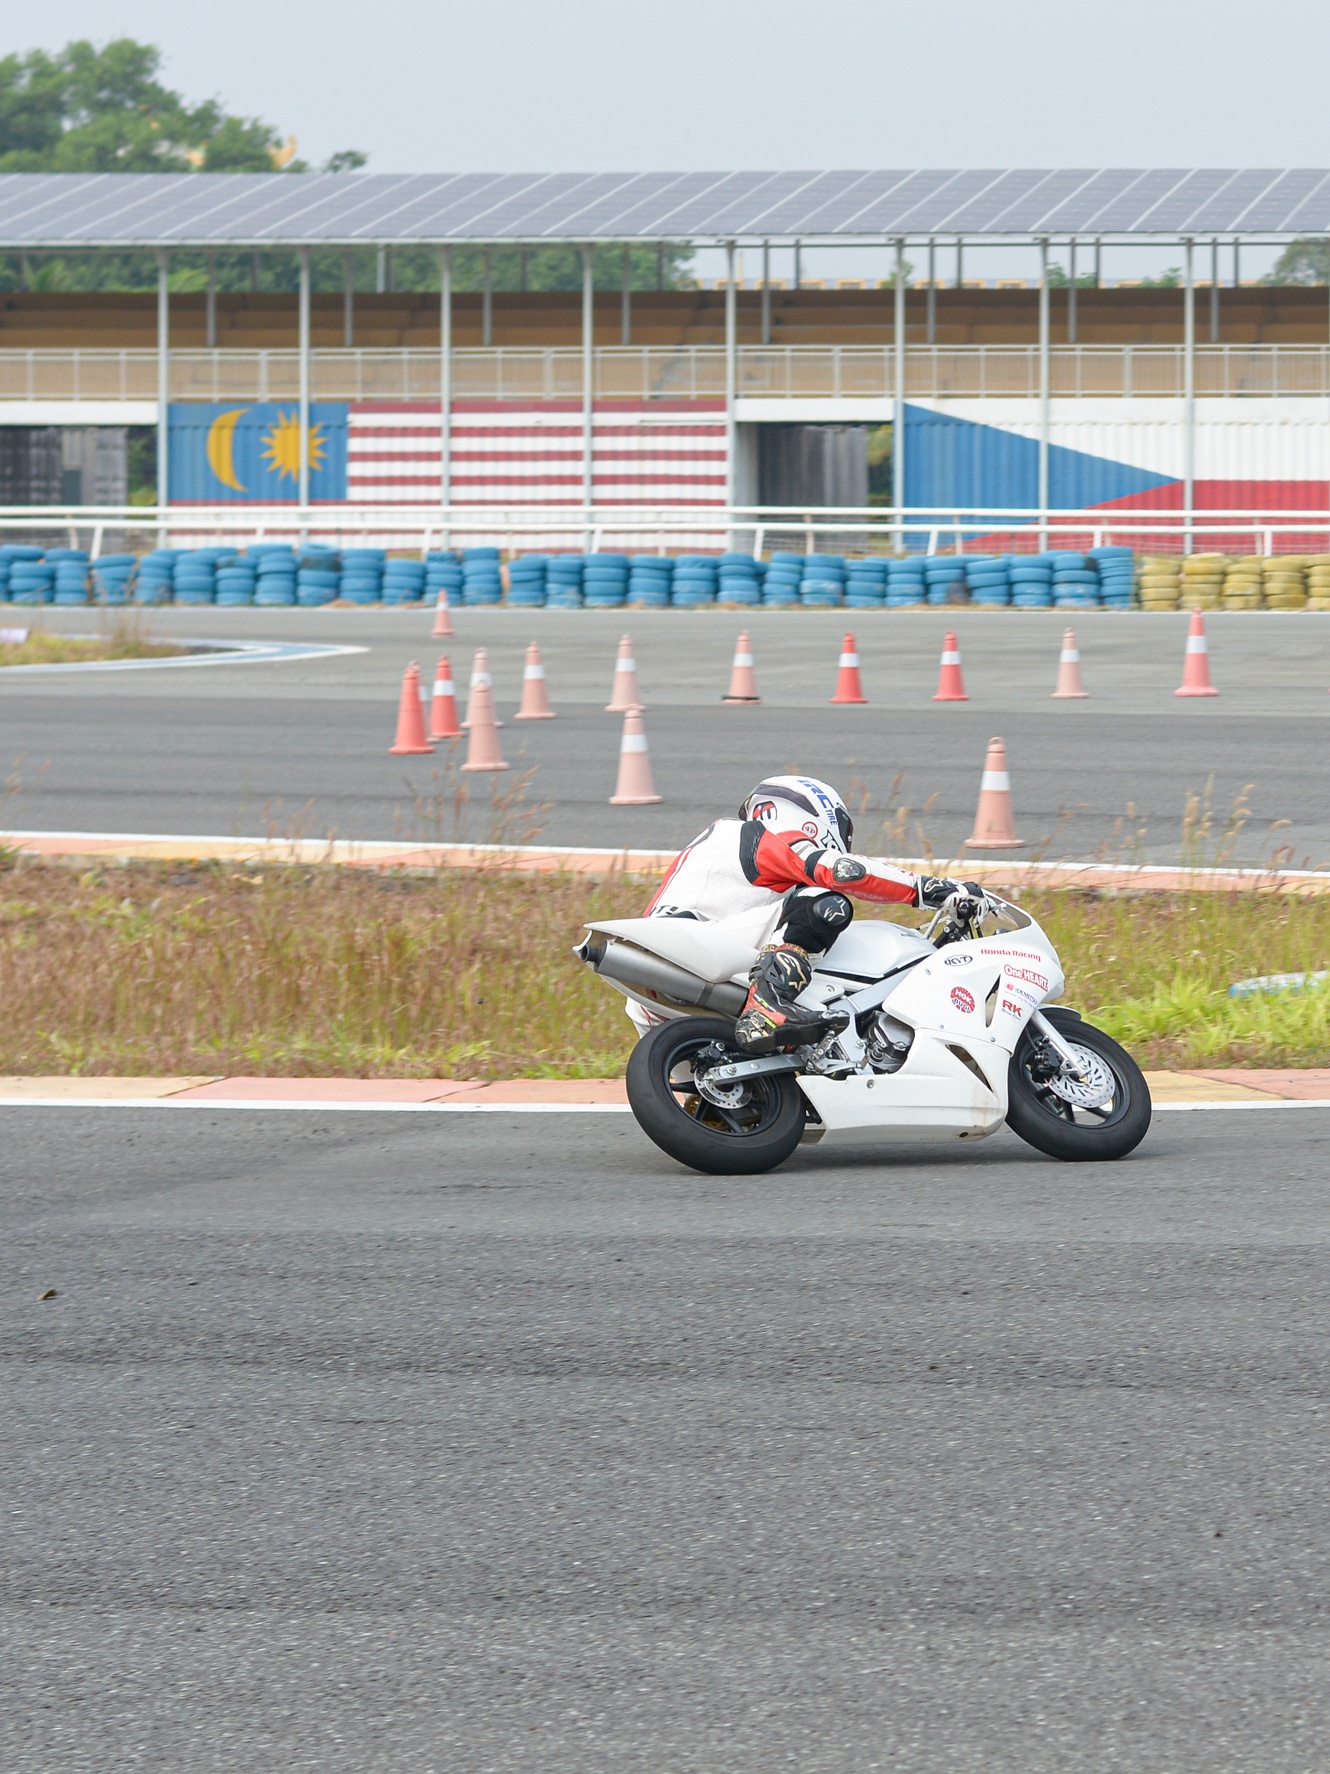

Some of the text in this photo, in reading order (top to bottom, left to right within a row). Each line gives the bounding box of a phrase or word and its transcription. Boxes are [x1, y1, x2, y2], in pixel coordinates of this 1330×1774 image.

[981, 948, 1041, 962] Honda Racing
[1004, 964, 1023, 979] One
[1002, 999, 1023, 1017] RK
